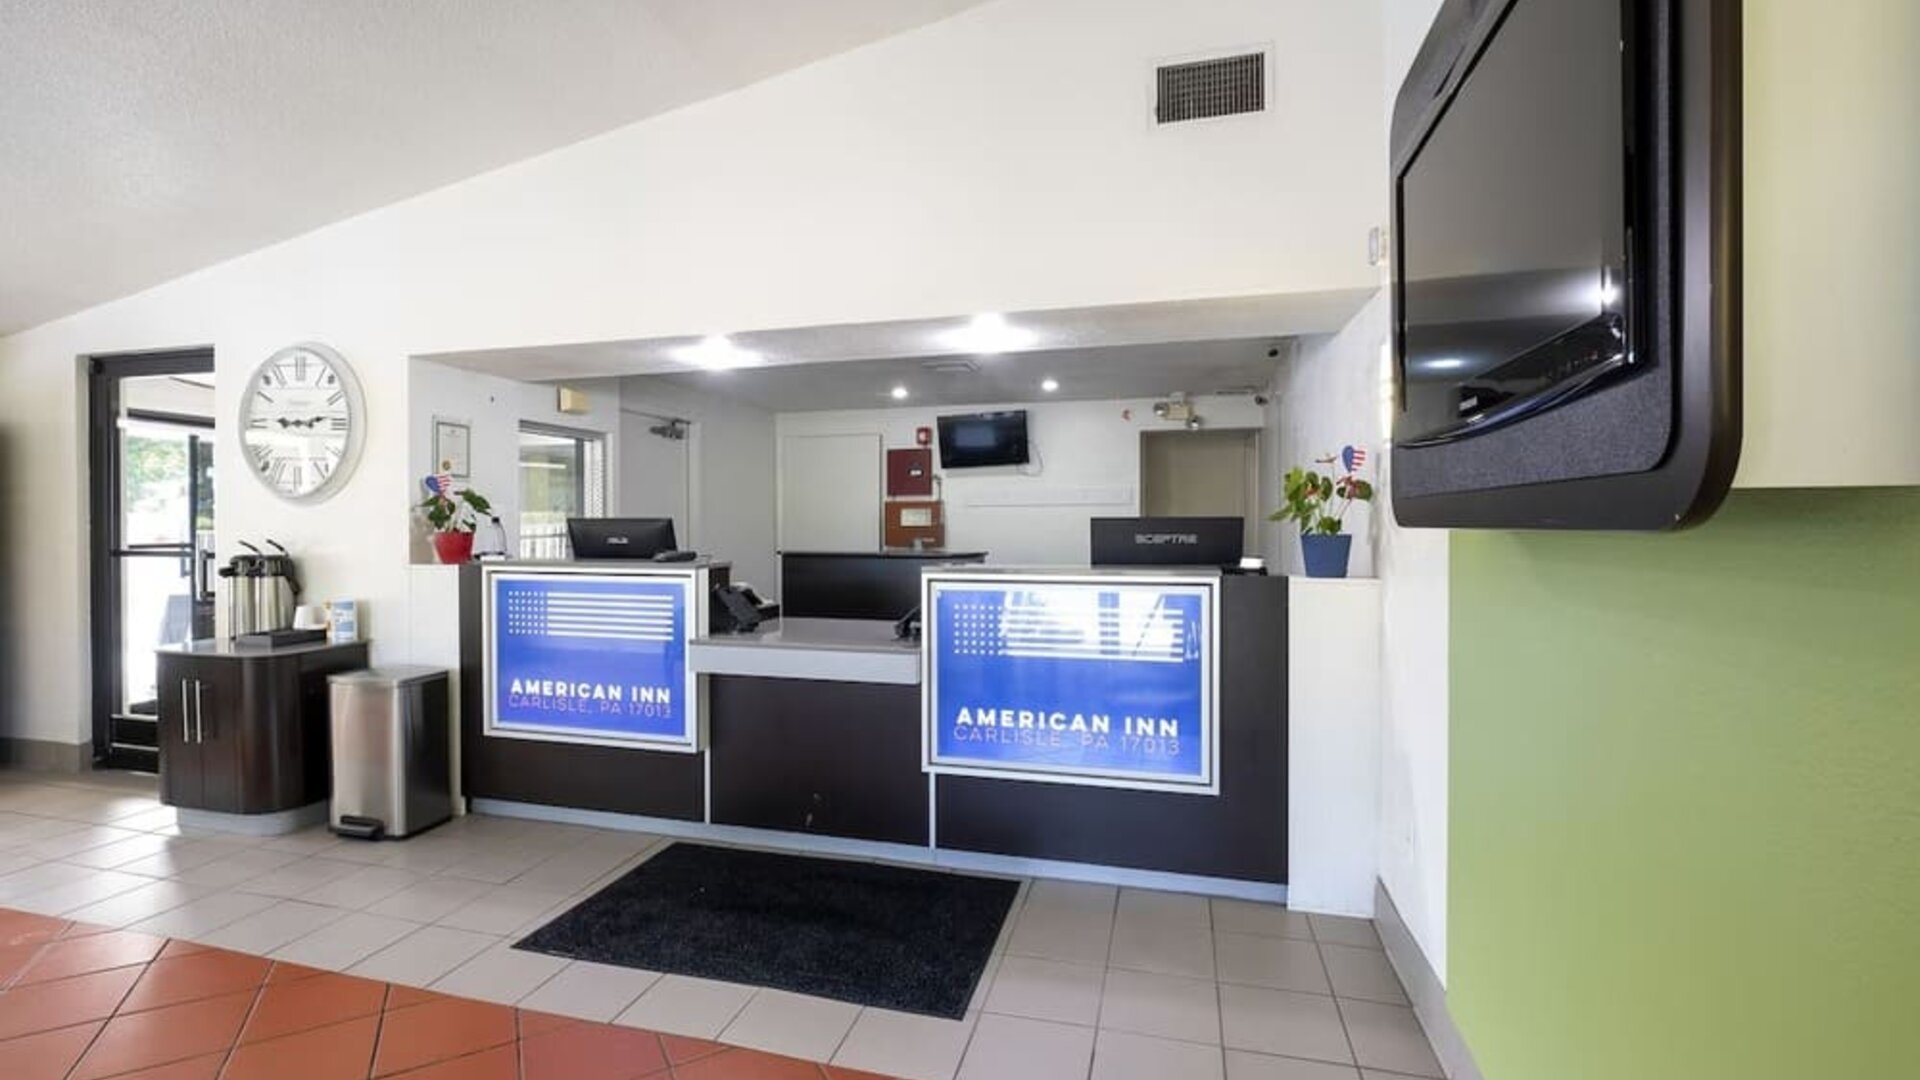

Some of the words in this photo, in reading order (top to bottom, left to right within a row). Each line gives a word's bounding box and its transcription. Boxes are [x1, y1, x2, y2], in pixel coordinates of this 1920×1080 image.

[510, 678, 622, 701] AMERICAN
[631, 685, 671, 704] INN
[600, 701, 623, 715] PA
[628, 702, 672, 719] 17013
[956, 707, 1110, 734] AMERICAN
[1124, 715, 1178, 737] INN
[1080, 731, 1109, 749] PA
[1121, 736, 1181, 756] 17013
